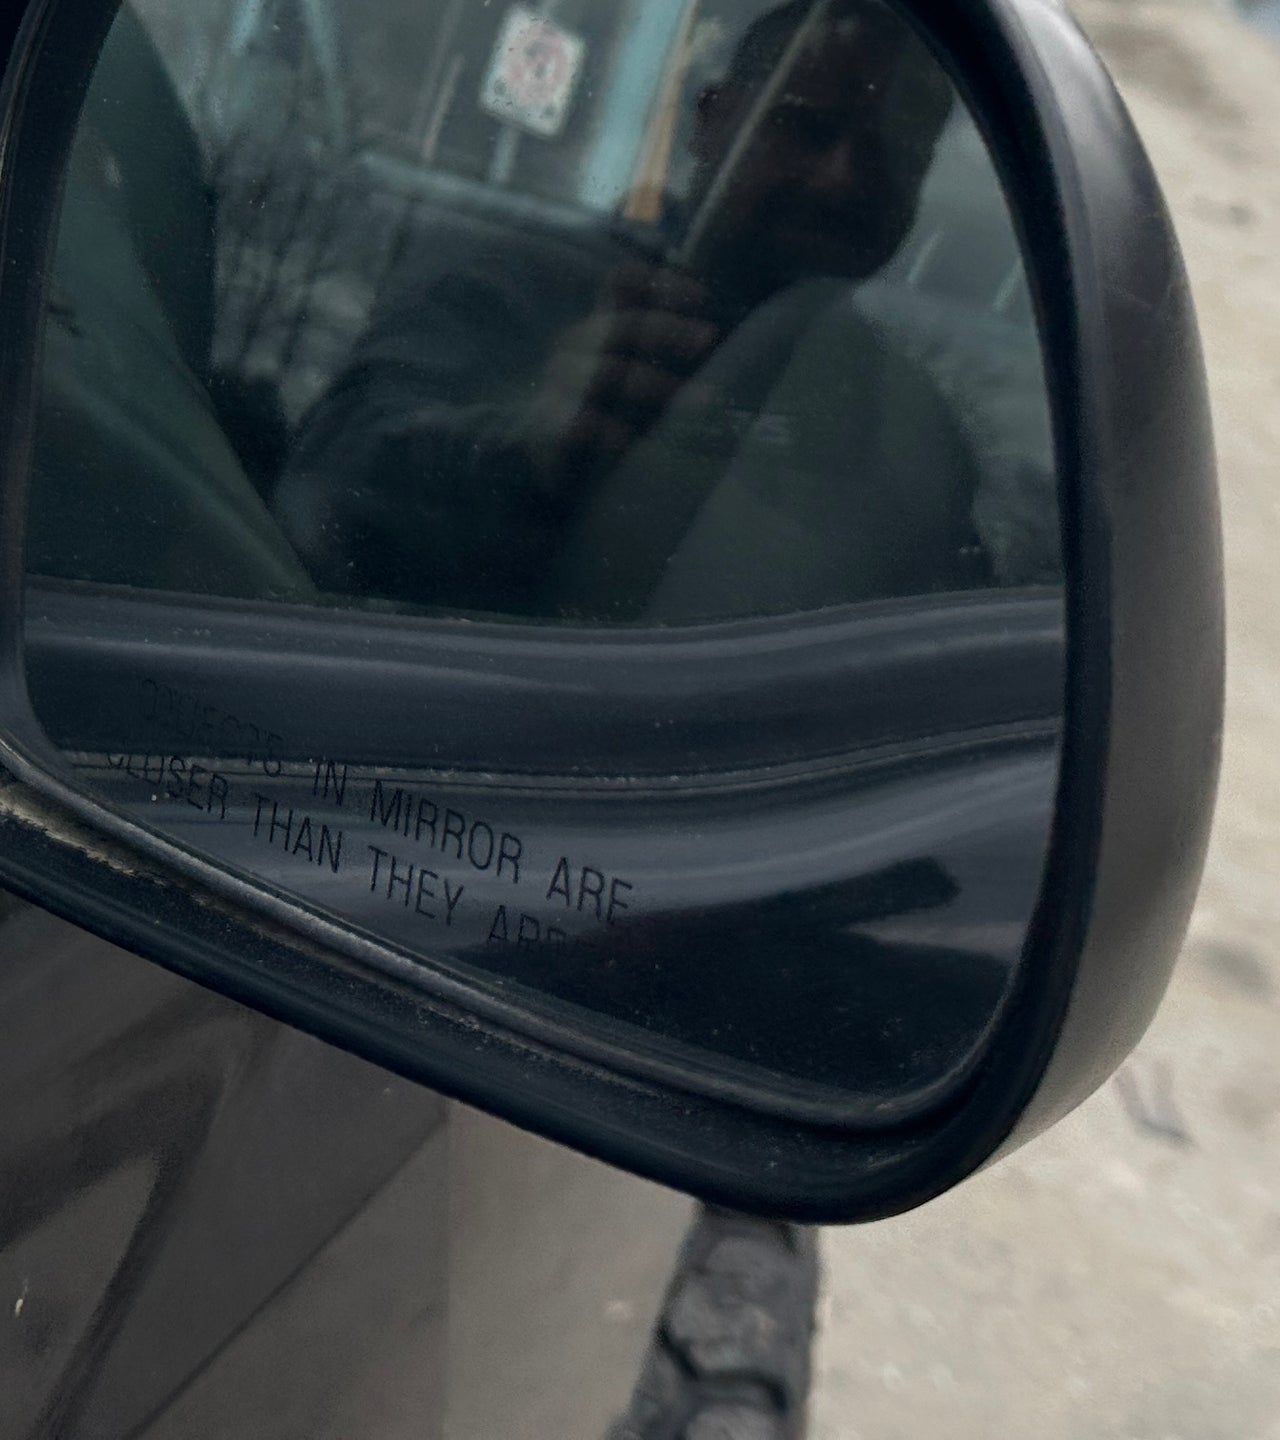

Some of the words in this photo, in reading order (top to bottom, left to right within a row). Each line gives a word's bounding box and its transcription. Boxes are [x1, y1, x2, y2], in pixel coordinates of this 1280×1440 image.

[252, 791, 344, 875] THAN
[367, 843, 466, 928] THEY
[313, 756, 349, 807] IN
[369, 778, 523, 885] MIRROR
